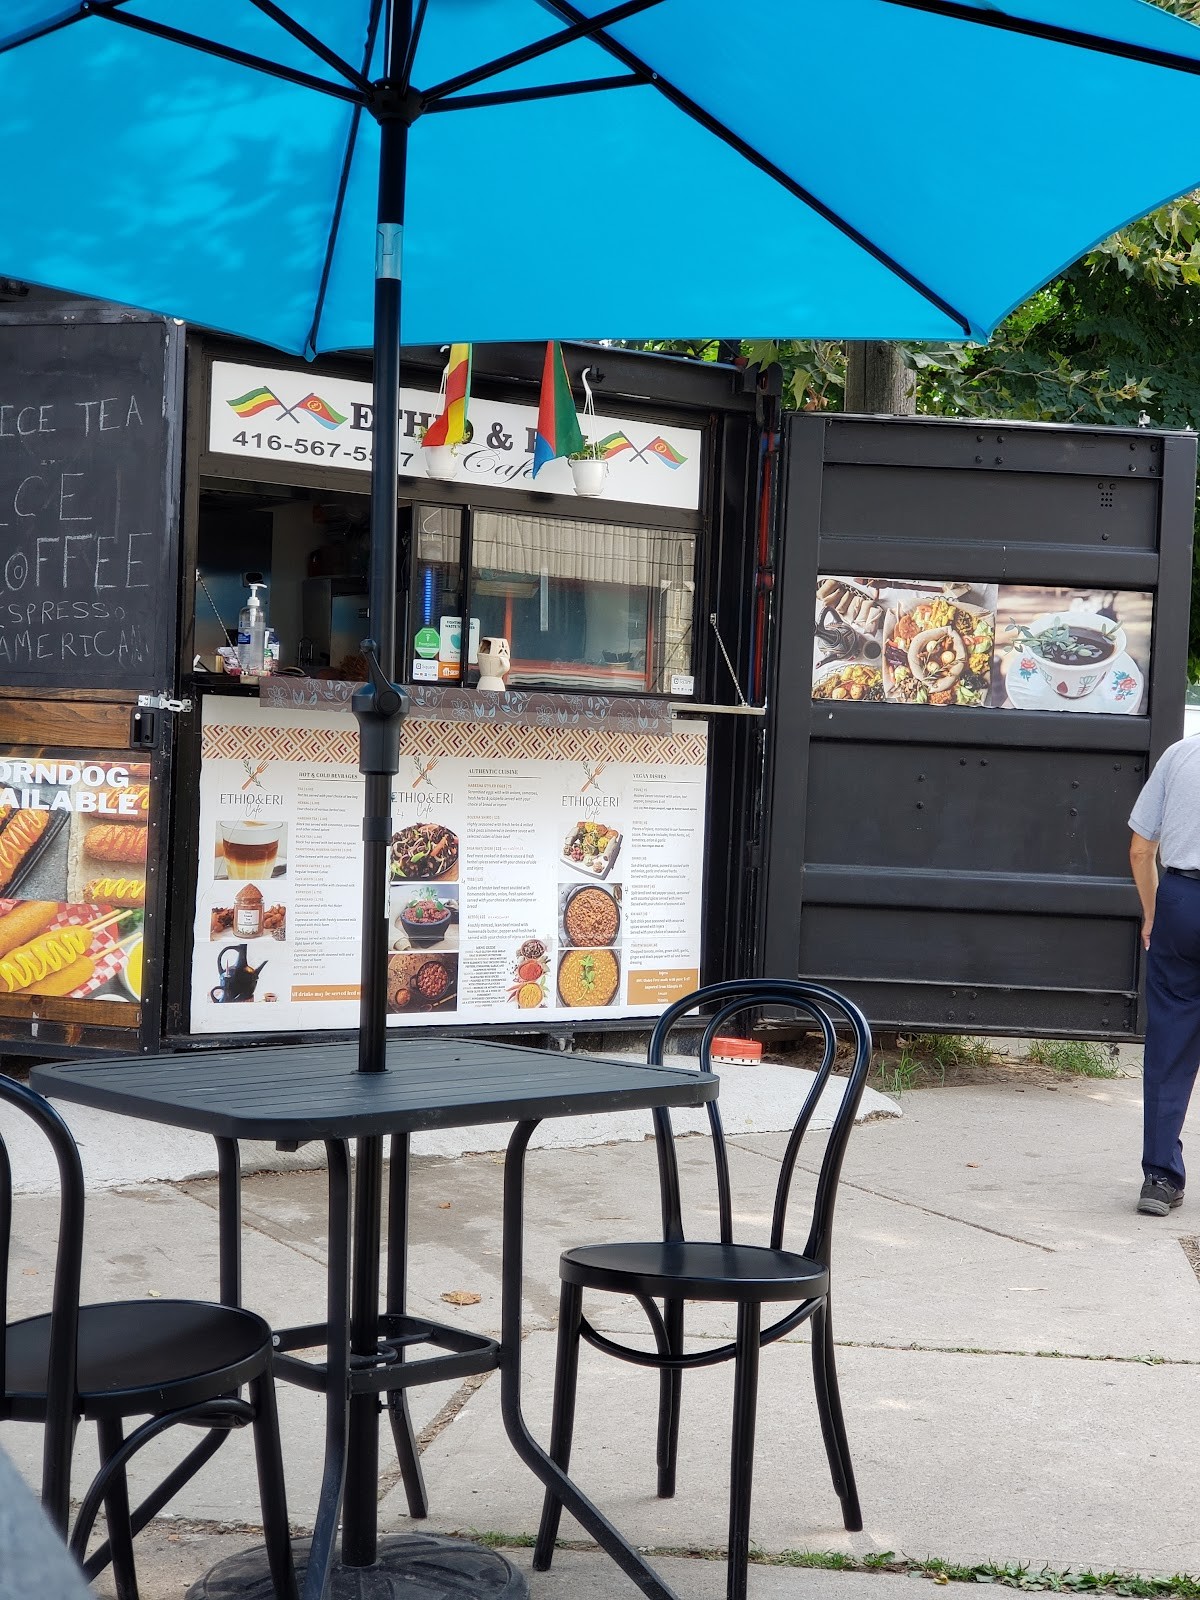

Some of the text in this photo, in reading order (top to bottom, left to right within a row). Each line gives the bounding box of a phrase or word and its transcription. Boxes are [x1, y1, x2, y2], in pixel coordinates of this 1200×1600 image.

[0, 395, 143, 437] ICE TEA
[232, 430, 414, 467] 416-567-57
[486, 422, 513, 451] &
[0, 473, 92, 526] CE
[0, 533, 152, 596] OFFEE
[0, 601, 125, 624] SPRESSO
